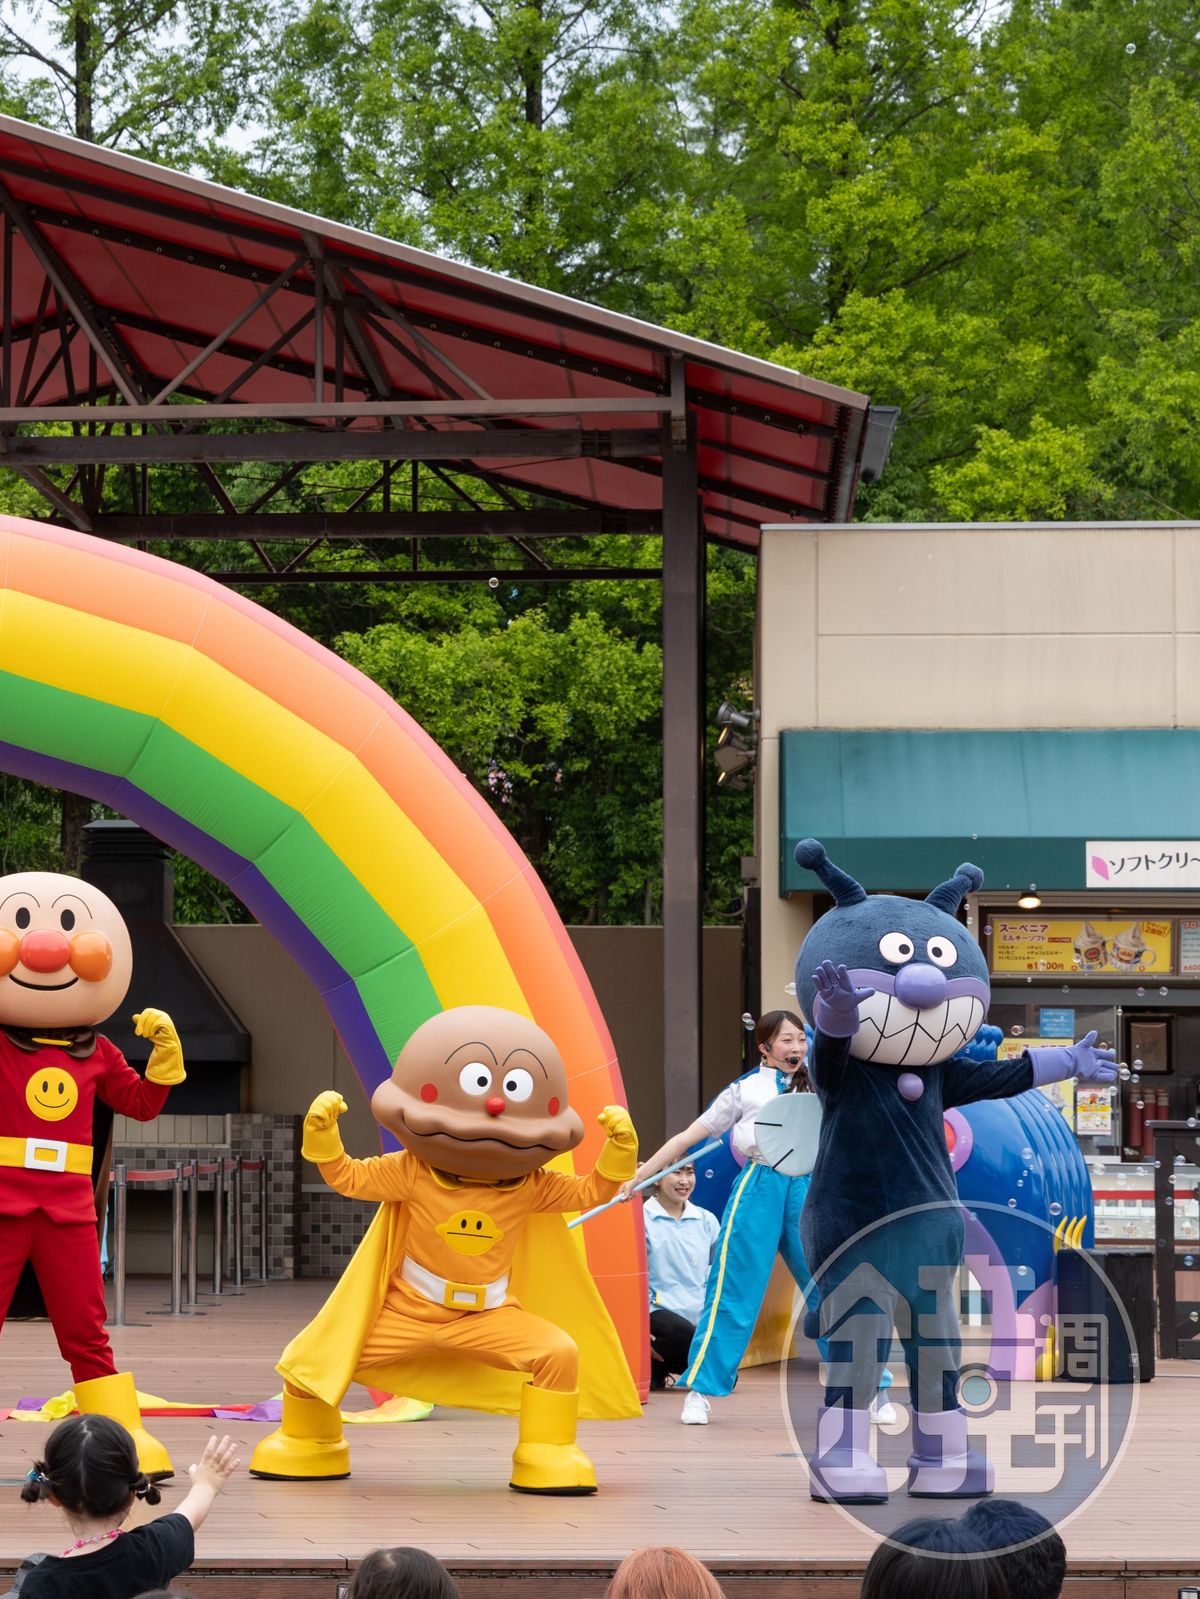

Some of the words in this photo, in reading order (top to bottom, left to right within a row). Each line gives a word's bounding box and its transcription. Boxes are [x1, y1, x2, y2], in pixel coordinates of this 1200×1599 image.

[1000, 924, 1049, 933] スーベニア
